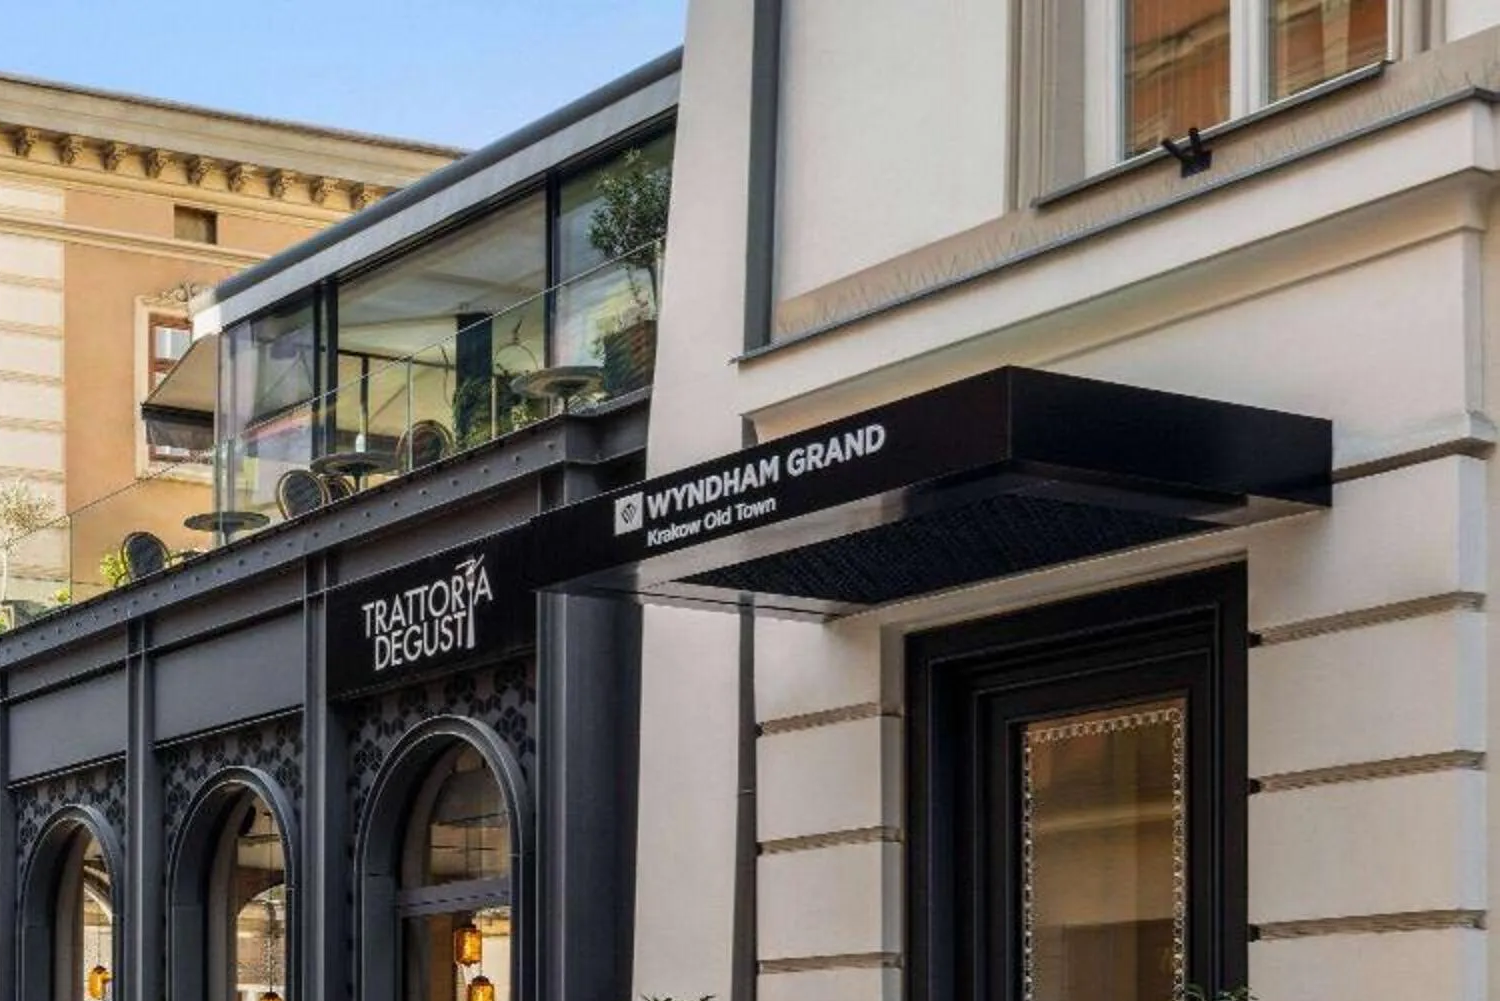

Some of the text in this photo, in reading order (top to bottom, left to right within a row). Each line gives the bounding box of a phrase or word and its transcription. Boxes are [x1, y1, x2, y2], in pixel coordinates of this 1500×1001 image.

[647, 424, 886, 519] WYNDHAM GRAND
[647, 497, 777, 546] Krakow Old Town
[362, 554, 493, 639] TRATTORIA
